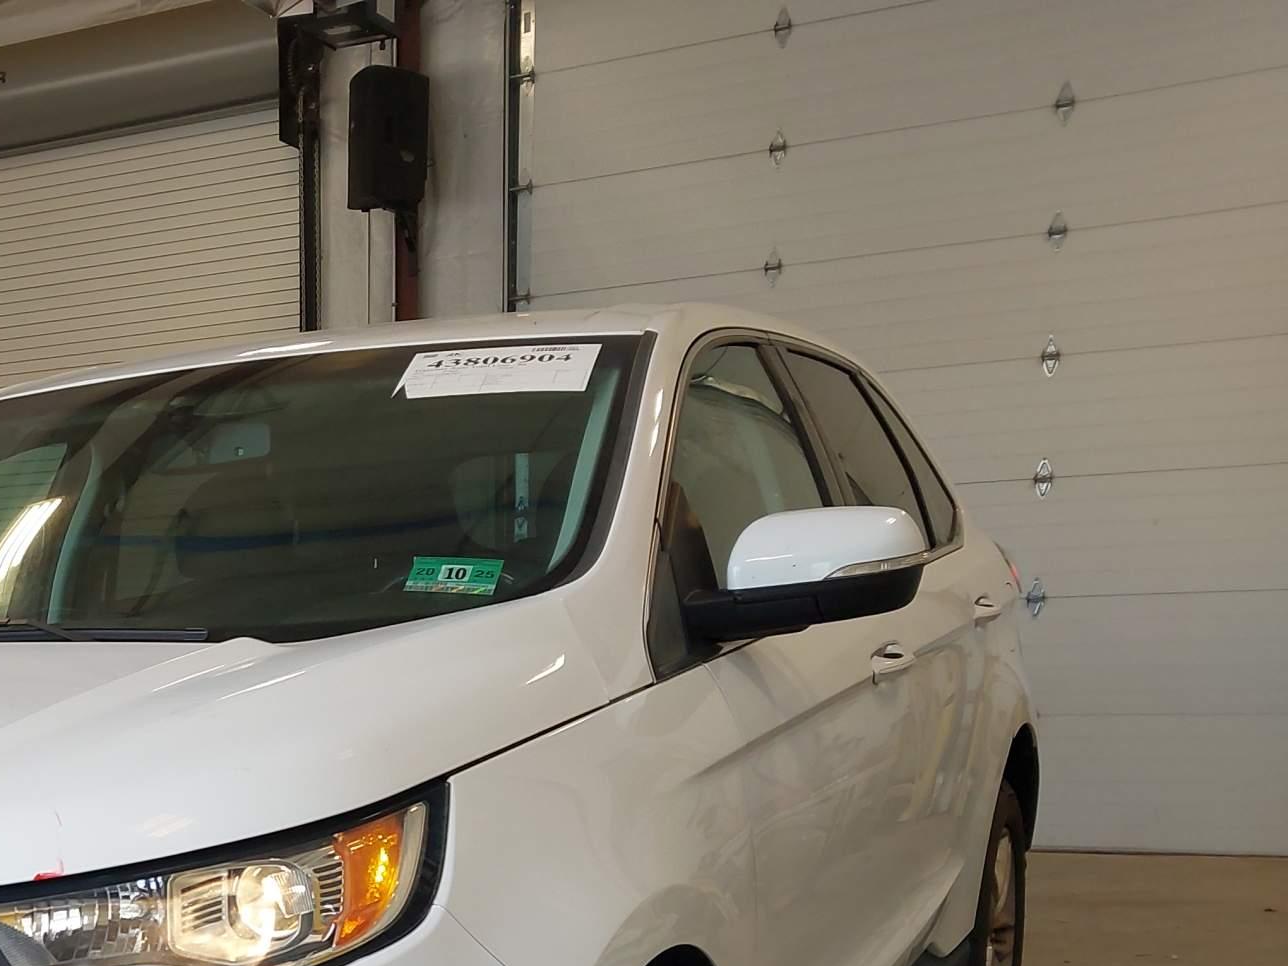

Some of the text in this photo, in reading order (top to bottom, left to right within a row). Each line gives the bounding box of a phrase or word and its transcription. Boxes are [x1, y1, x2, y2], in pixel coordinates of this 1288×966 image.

[427, 353, 573, 368] 43806904
[415, 567, 495, 580] 20 10 25
